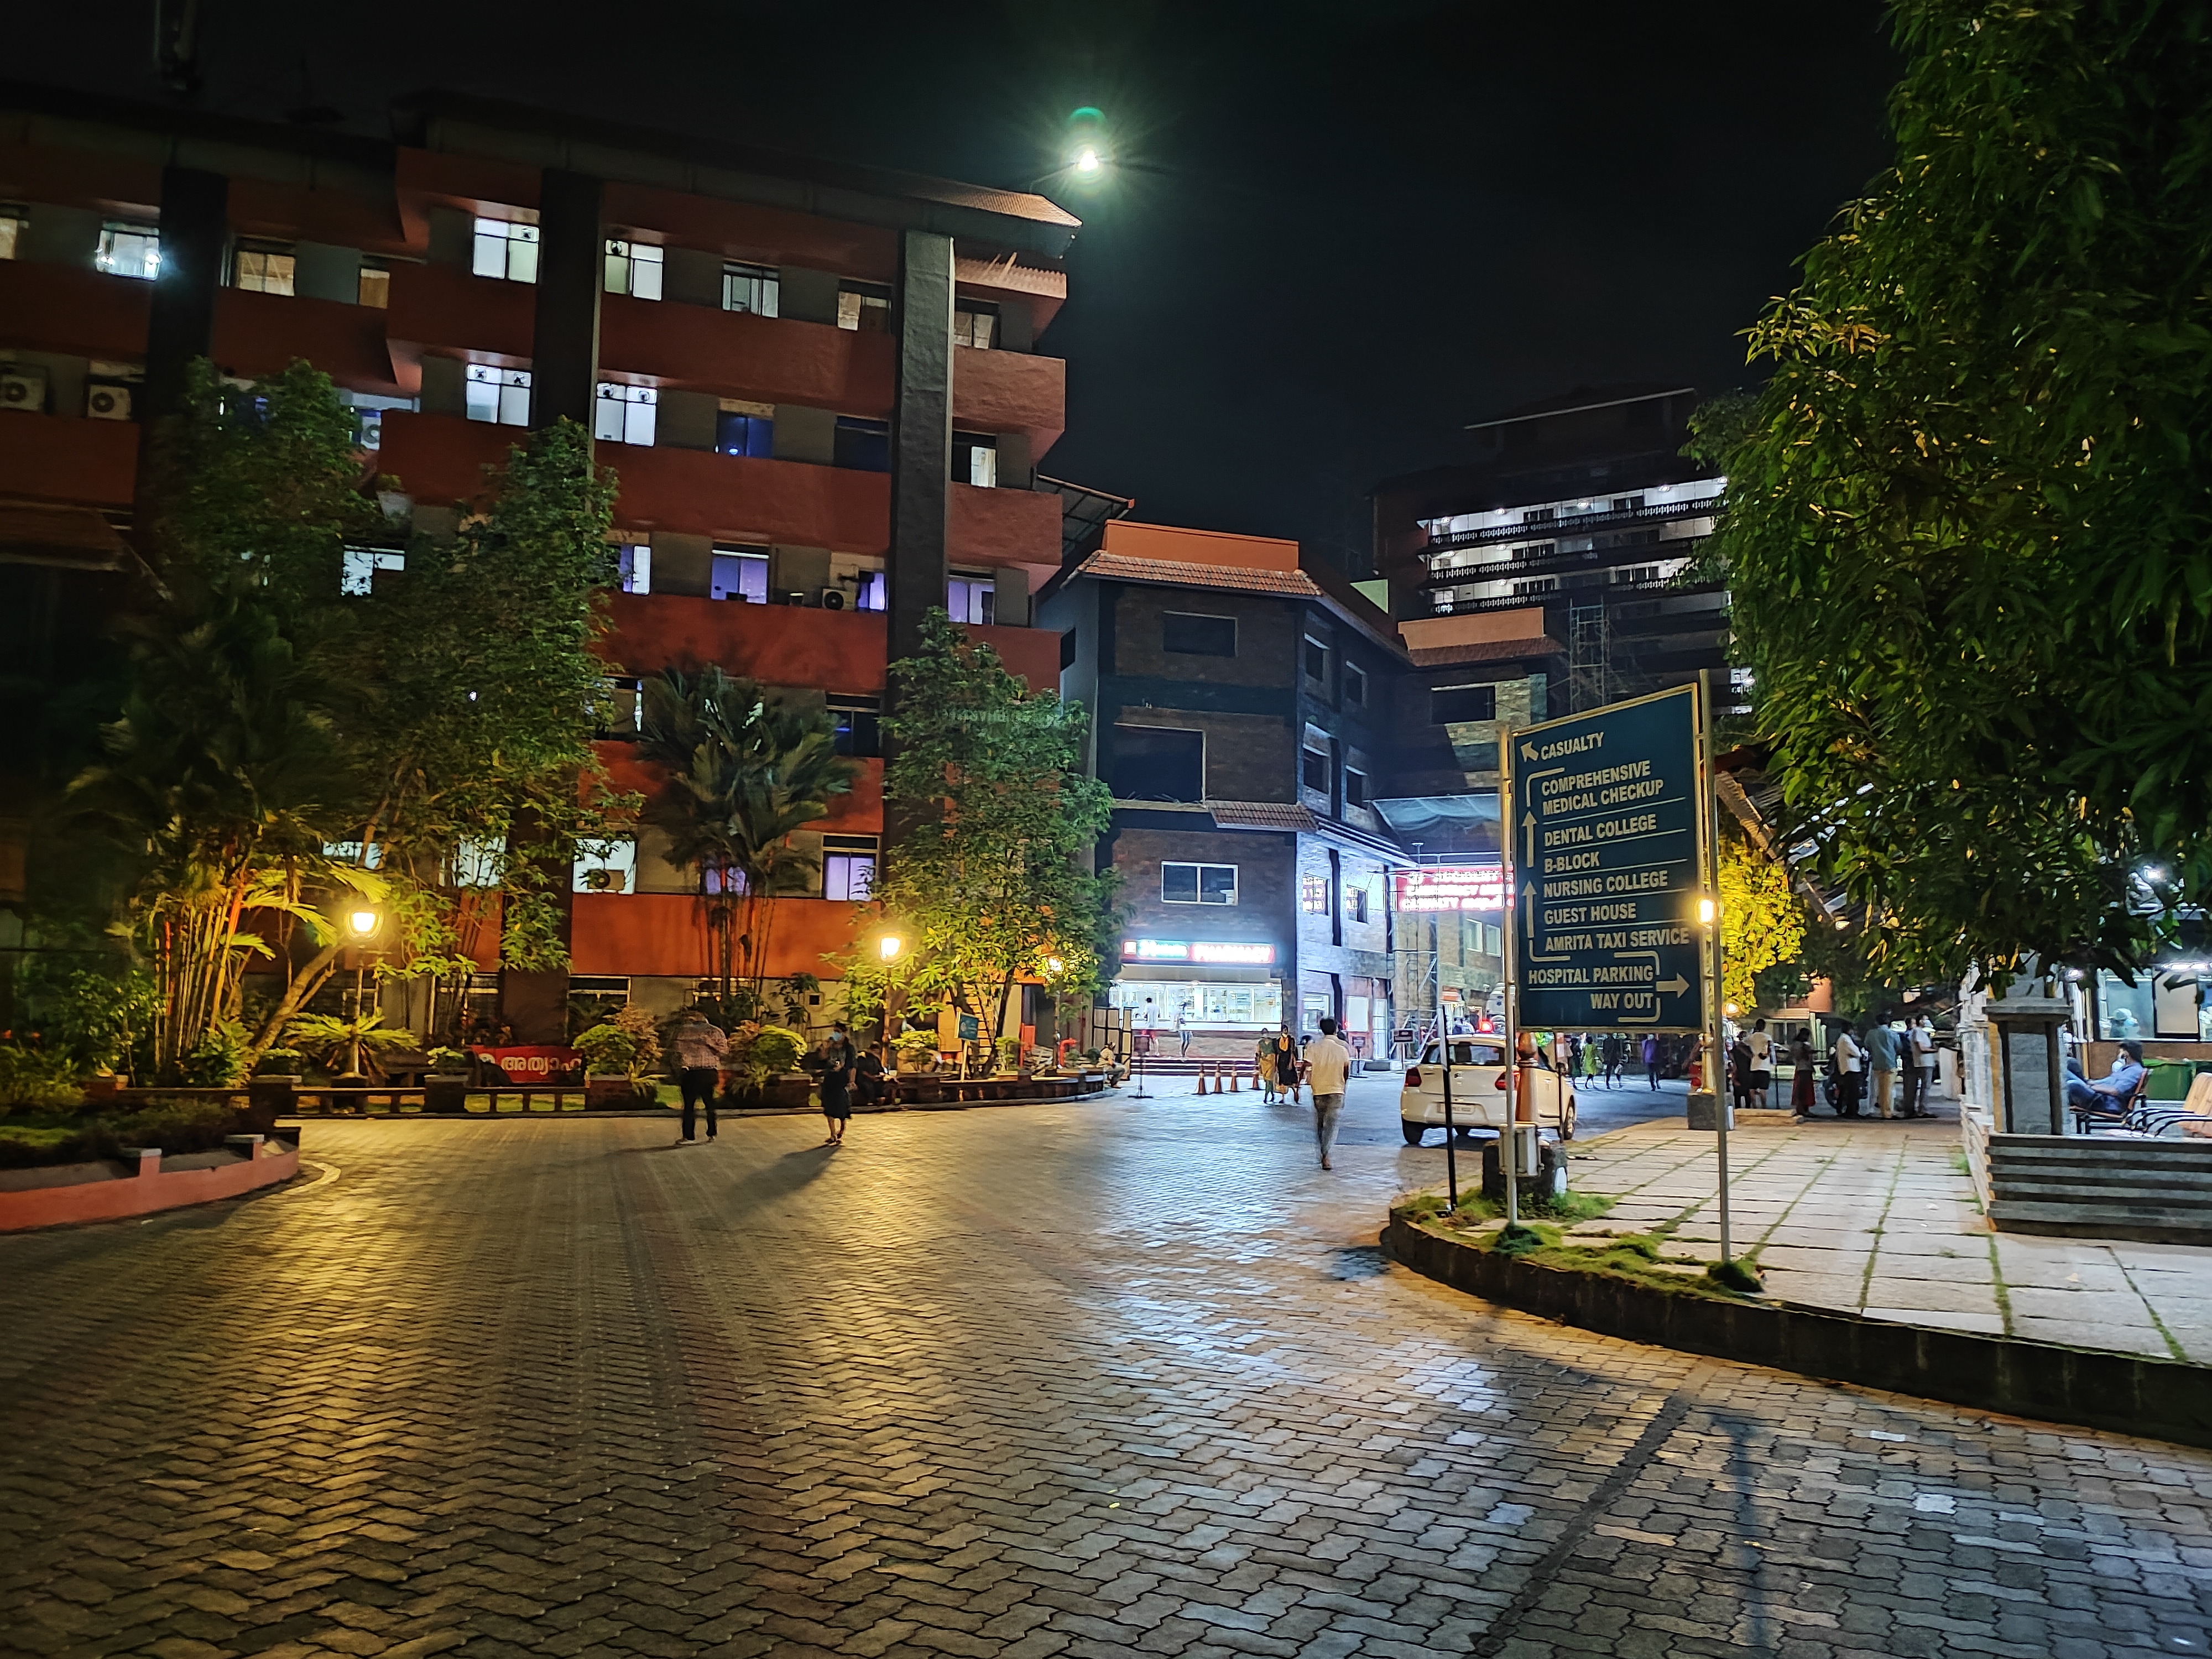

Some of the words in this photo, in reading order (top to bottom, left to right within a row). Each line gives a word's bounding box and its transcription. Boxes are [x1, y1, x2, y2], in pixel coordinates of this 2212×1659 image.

[1541, 732, 1604, 760] CASUALTY
[1542, 760, 1650, 796] COMPREHENSIVE
[1543, 793, 1598, 816] MEDICAL
[1601, 779, 1664, 805] CHECKUP
[1545, 826, 1593, 847] DENTAL
[1597, 813, 1656, 838] COLLEGE
[1545, 852, 1600, 873] B-BLOCK
[1543, 877, 1602, 898] NURSING
[1606, 870, 1667, 891] COLLEGE
[1544, 907, 1588, 925] GUEST
[1591, 902, 1636, 921] HOUSE
[1545, 935, 1593, 951] AMRITA
[1597, 932, 1626, 948] TAXI
[1630, 928, 1689, 947] SERVICE
[1528, 968, 1589, 984] HOSPITAL
[1593, 966, 1653, 983] PARKING
[1591, 993, 1620, 1009] WAY
[1624, 993, 1653, 1009] OUT
